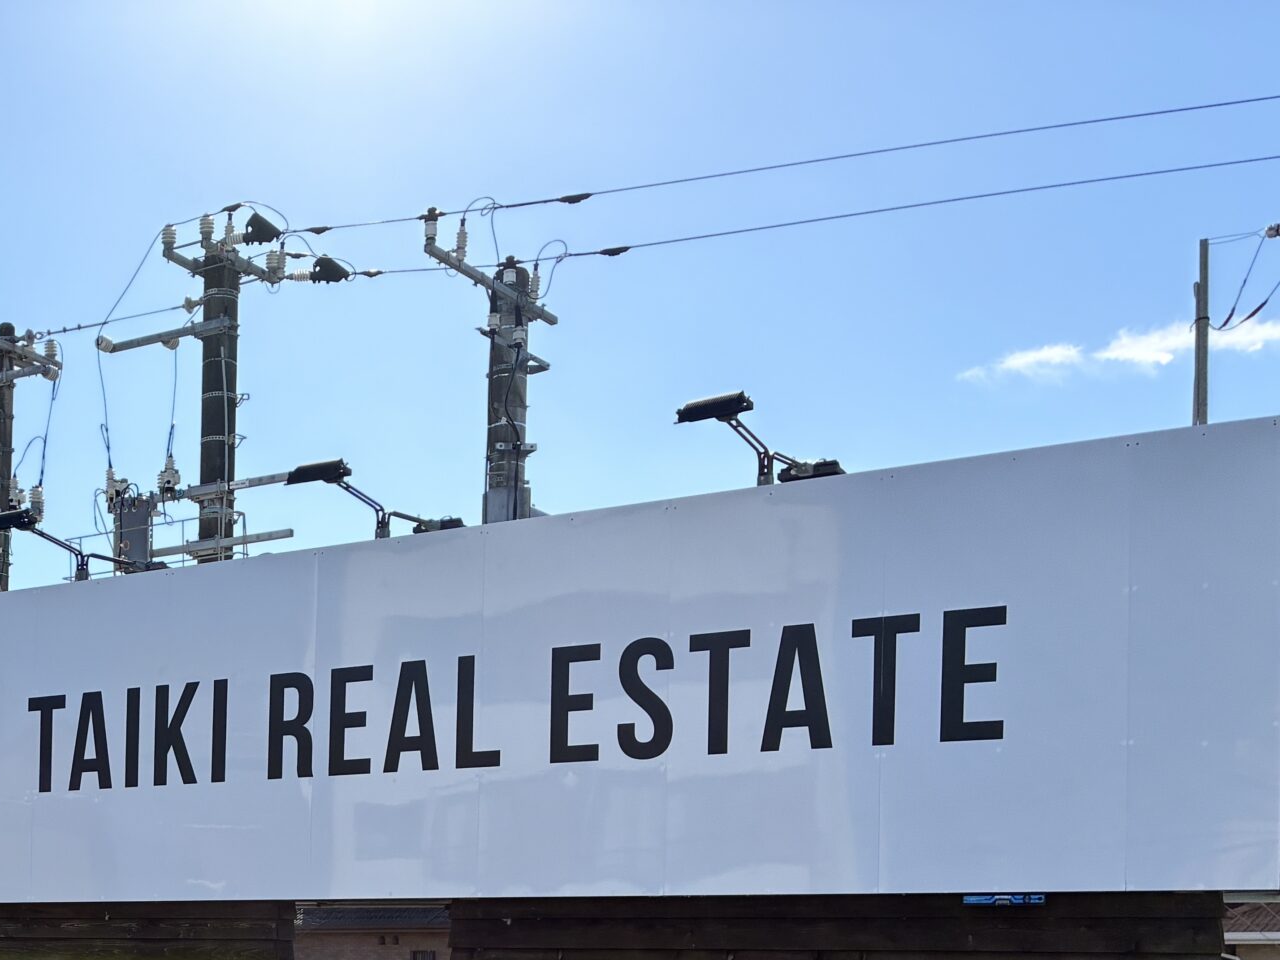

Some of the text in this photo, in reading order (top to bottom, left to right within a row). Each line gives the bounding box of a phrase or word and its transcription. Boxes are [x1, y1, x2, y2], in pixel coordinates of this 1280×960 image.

[28, 606, 1007, 792] TAIKI REAL ESTATE
